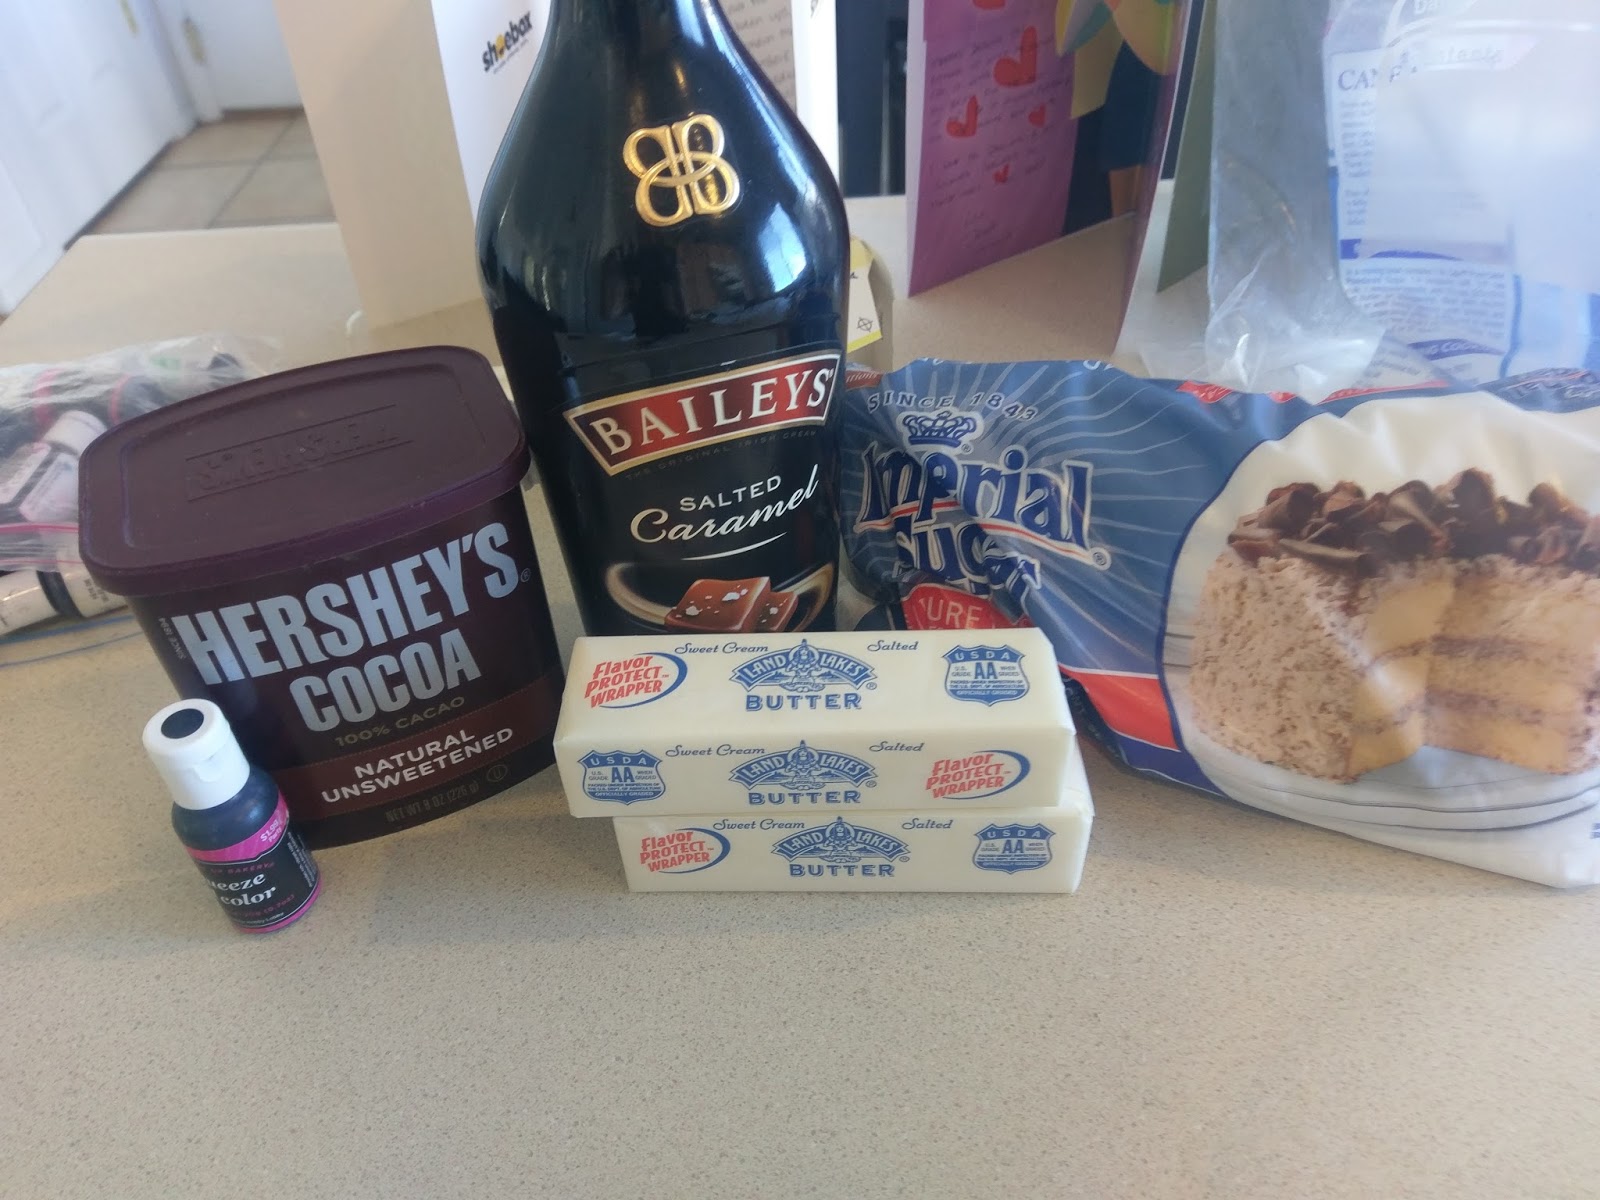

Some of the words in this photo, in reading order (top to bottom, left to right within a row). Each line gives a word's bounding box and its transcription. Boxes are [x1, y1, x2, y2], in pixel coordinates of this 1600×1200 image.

[482, 11, 532, 72] shoebox
[590, 367, 829, 456] BAILEYS
[867, 391, 954, 412] SINCE
[970, 392, 1038, 421] 1843
[630, 464, 819, 543] Caramel
[680, 475, 782, 512] SALTED
[855, 441, 1094, 551] Imprial
[172, 522, 519, 685] HERSHEY'S
[919, 596, 983, 629] URE
[674, 642, 719, 654] Sweet
[722, 642, 768, 654] Cream
[867, 640, 919, 651] Salted
[592, 656, 653, 680] Flavor
[743, 655, 787, 678] LAND
[820, 654, 864, 676] LAKES
[974, 662, 998, 679] AA
[289, 628, 482, 732] COCOA
[584, 666, 662, 698] PROTECT
[590, 680, 663, 708] WRAPPER
[746, 692, 862, 711] BUTTER
[335, 725, 390, 747] 100%
[395, 697, 465, 726] CACAO
[354, 729, 475, 778] NATURAL
[665, 744, 712, 757] Sweet
[716, 744, 765, 756] Cream
[869, 741, 925, 752] Salted
[321, 728, 513, 803] UNSWEETENED
[611, 767, 635, 782] AA
[741, 756, 785, 778] LAND
[819, 755, 864, 777] LAKES
[932, 753, 994, 776] Flavor
[925, 763, 1004, 790] PROTECT
[932, 776, 1004, 799] WRAPPER
[748, 790, 861, 805] BUTTER
[713, 818, 756, 830] Sweet
[759, 818, 806, 830] Cream
[901, 818, 953, 830] Salted
[640, 841, 706, 864] PROTECT
[641, 831, 694, 851] Flavor
[783, 831, 823, 853] LAND
[856, 831, 898, 852] LAKES
[1001, 839, 1024, 854] AA
[647, 852, 710, 873] WRAPPER
[789, 864, 895, 877] BUTTER
[209, 873, 266, 891] ueeze
[220, 886, 276, 906] color
